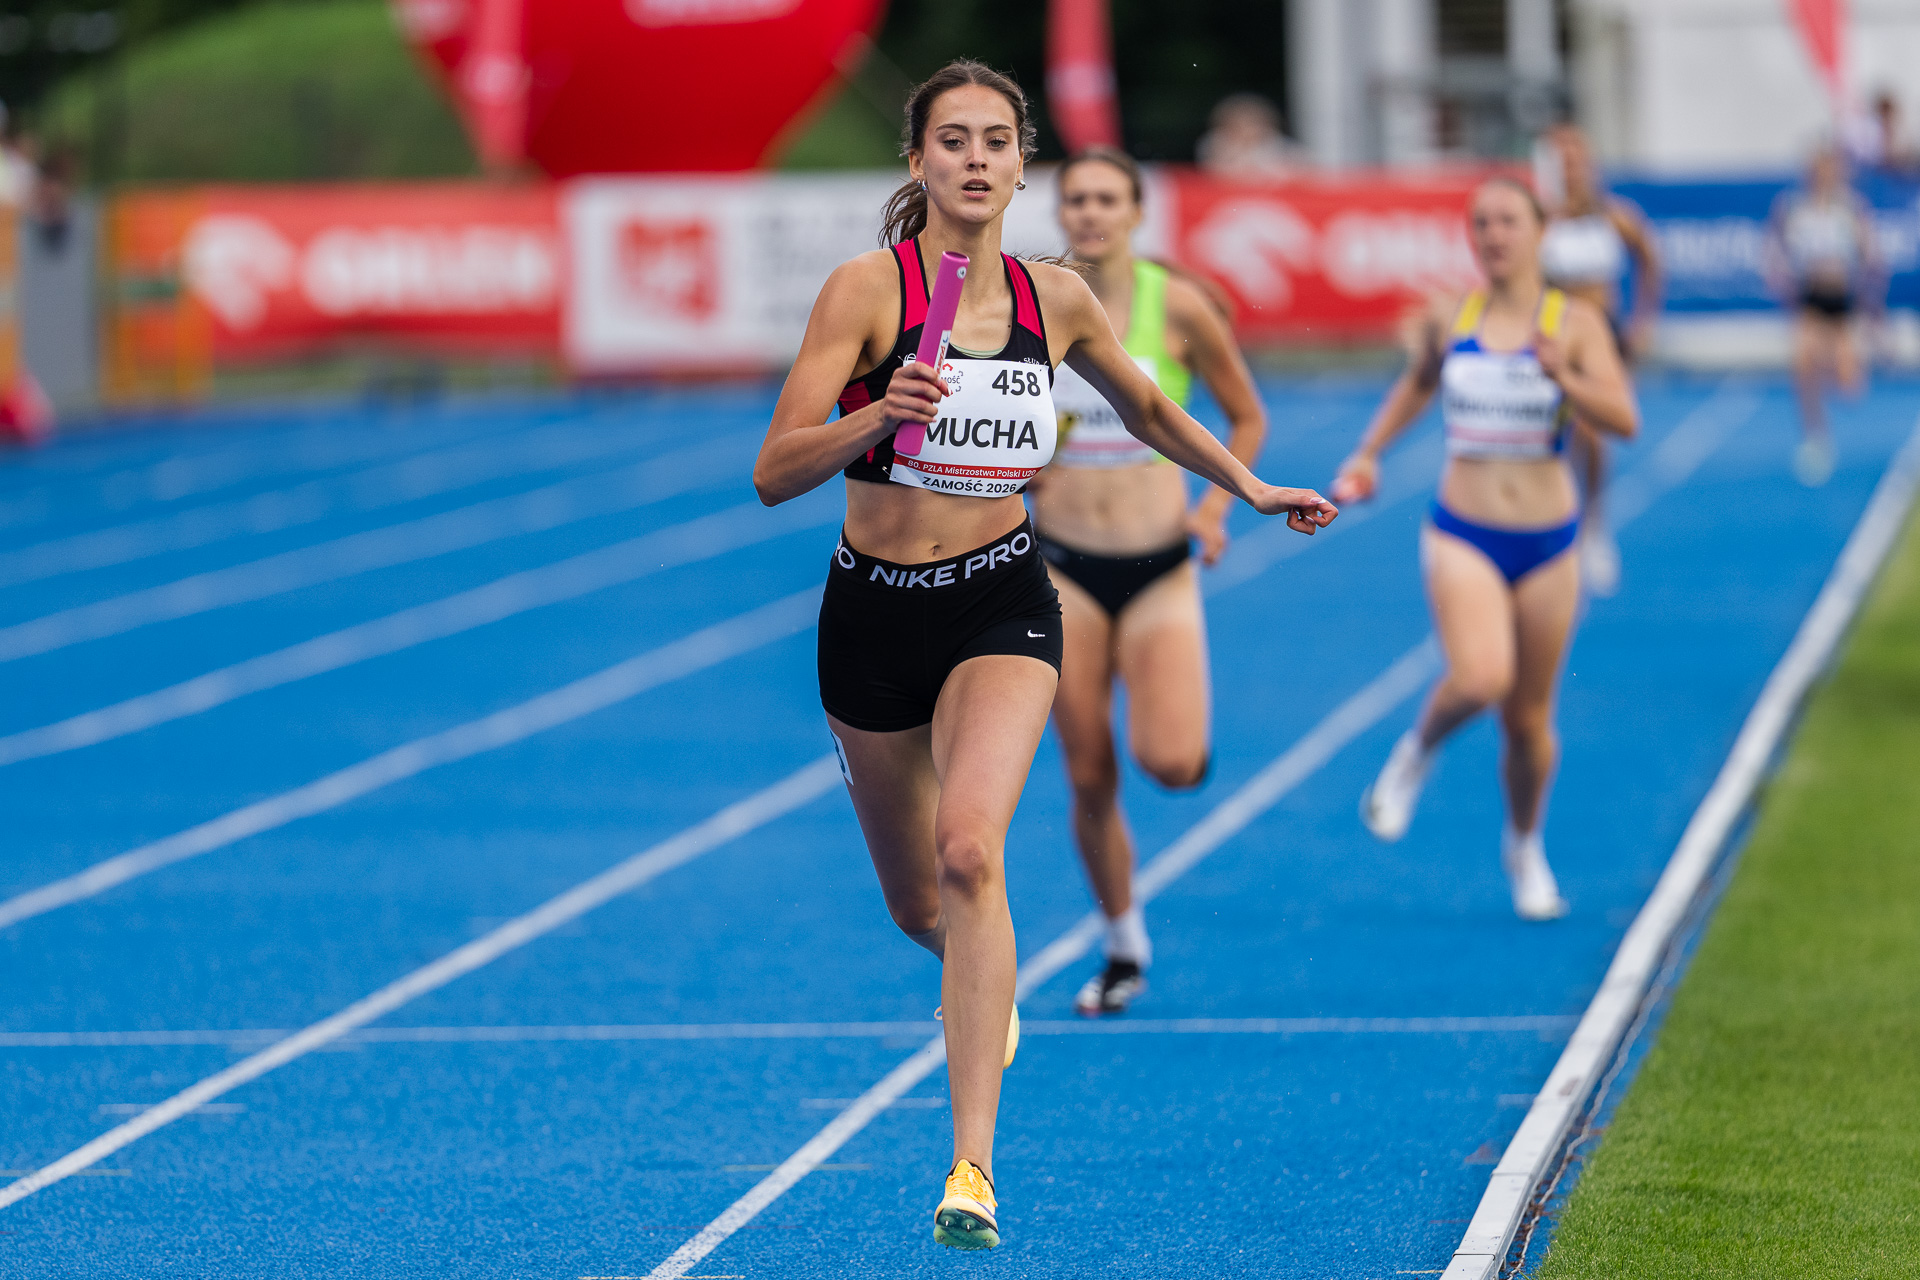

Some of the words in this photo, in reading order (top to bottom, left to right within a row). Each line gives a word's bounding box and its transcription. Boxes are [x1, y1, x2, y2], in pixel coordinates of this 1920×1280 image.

[991, 369, 1041, 397] 458
[926, 417, 1039, 450] MUCHA
[907, 459, 921, 471] 80.
[922, 463, 943, 474] PZLA
[944, 465, 995, 477] Mistrzostwa
[996, 469, 1021, 478] Polski
[922, 476, 984, 492] ZAMOŚĆ
[985, 483, 1017, 493] 2026
[869, 563, 957, 589] NIKE
[964, 532, 1031, 580] PRO
